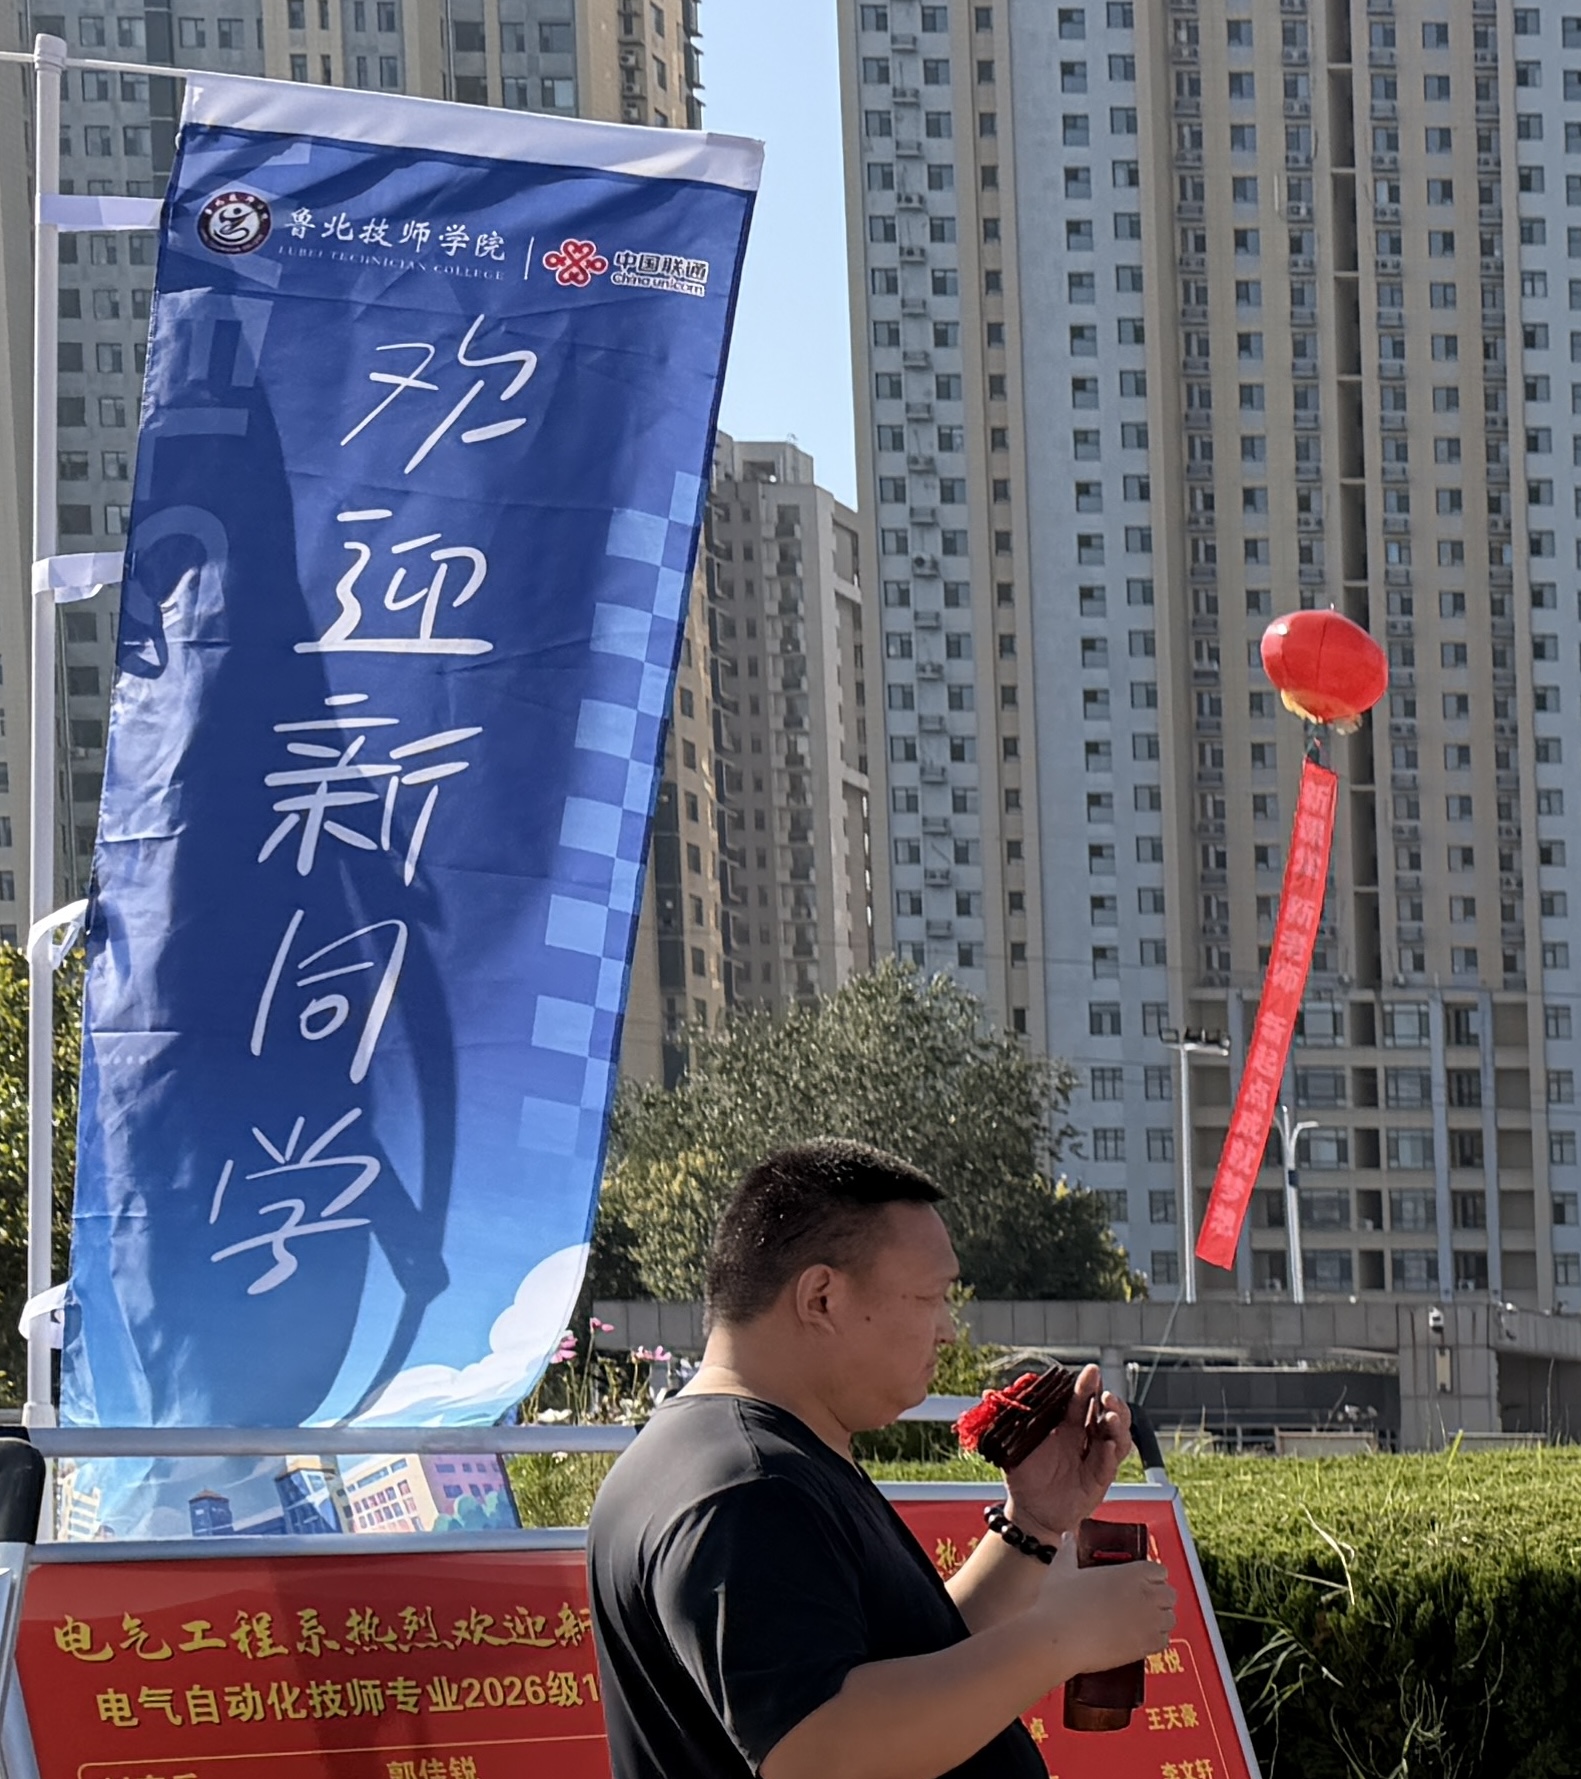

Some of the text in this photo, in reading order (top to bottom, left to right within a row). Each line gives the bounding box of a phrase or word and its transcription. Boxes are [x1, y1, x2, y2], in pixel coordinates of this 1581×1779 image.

[284, 207, 506, 261] 鲁北技师学院
[278, 245, 505, 281] LUBEI TECHNICIAN COLLEGE
[613, 250, 708, 283] 中国联通
[208, 313, 538, 1295] 欢迎新同学
[1147, 1703, 1199, 1731] 王天豪
